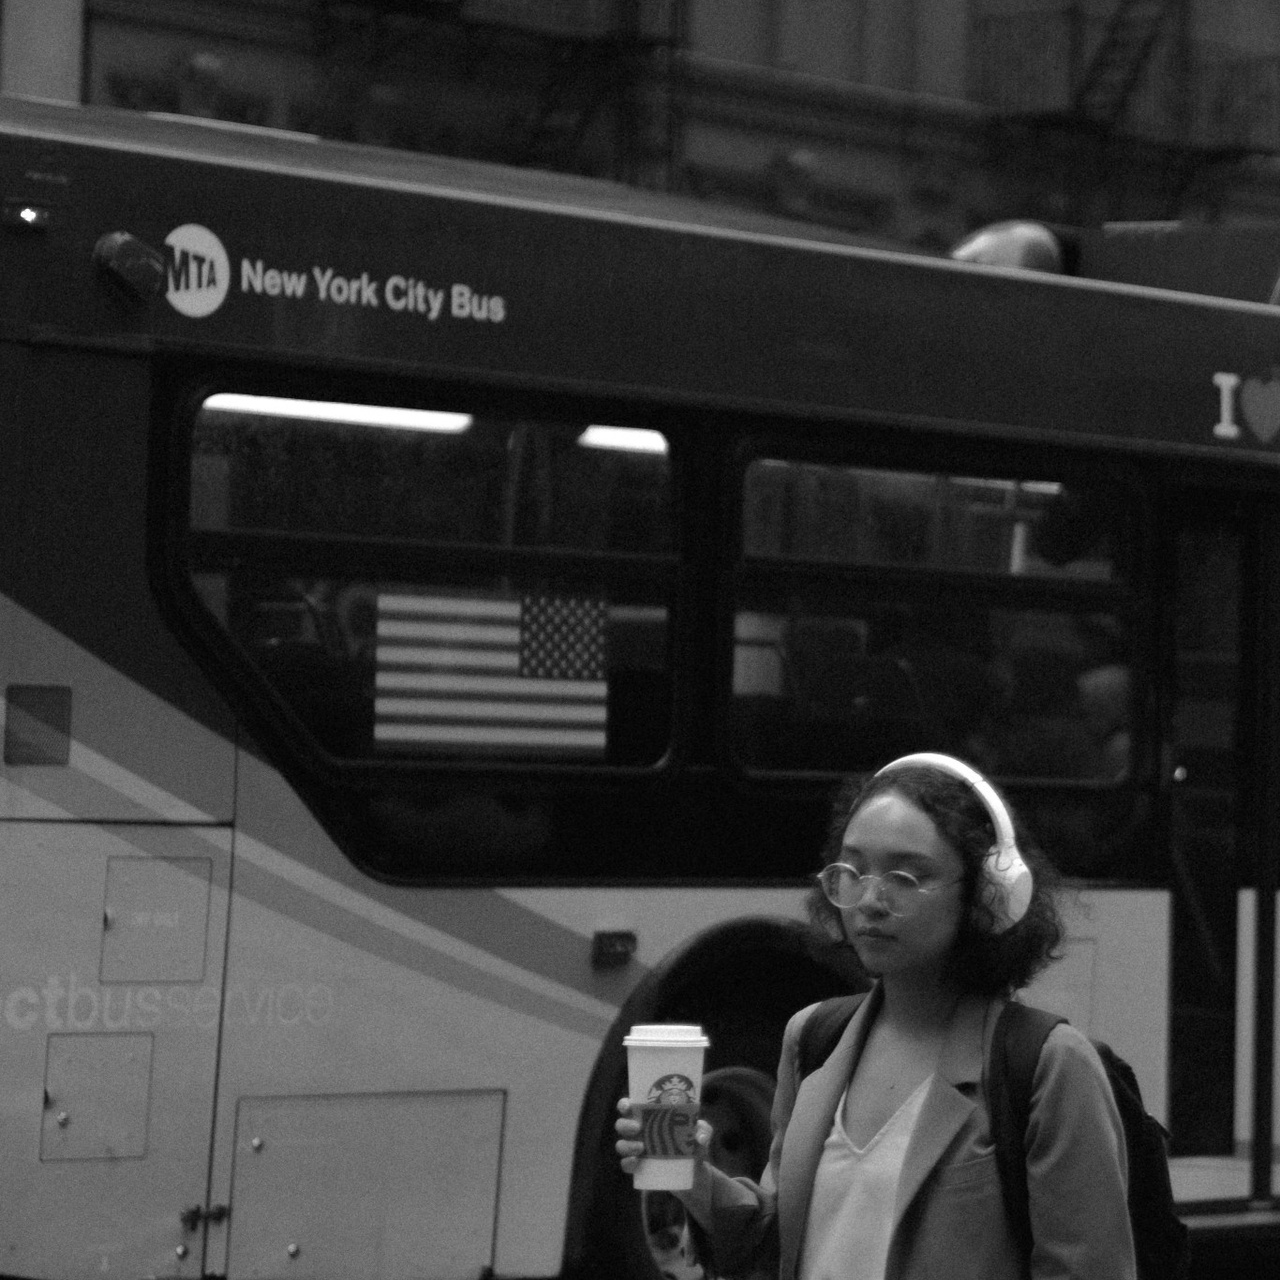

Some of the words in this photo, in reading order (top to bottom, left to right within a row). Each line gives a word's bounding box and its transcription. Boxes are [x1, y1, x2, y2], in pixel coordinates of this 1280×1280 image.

[164, 245, 219, 293] MTA
[241, 257, 308, 298] New
[312, 266, 379, 307] York
[385, 274, 444, 321] City
[451, 283, 506, 322] Bus
[1212, 372, 1240, 439] I
